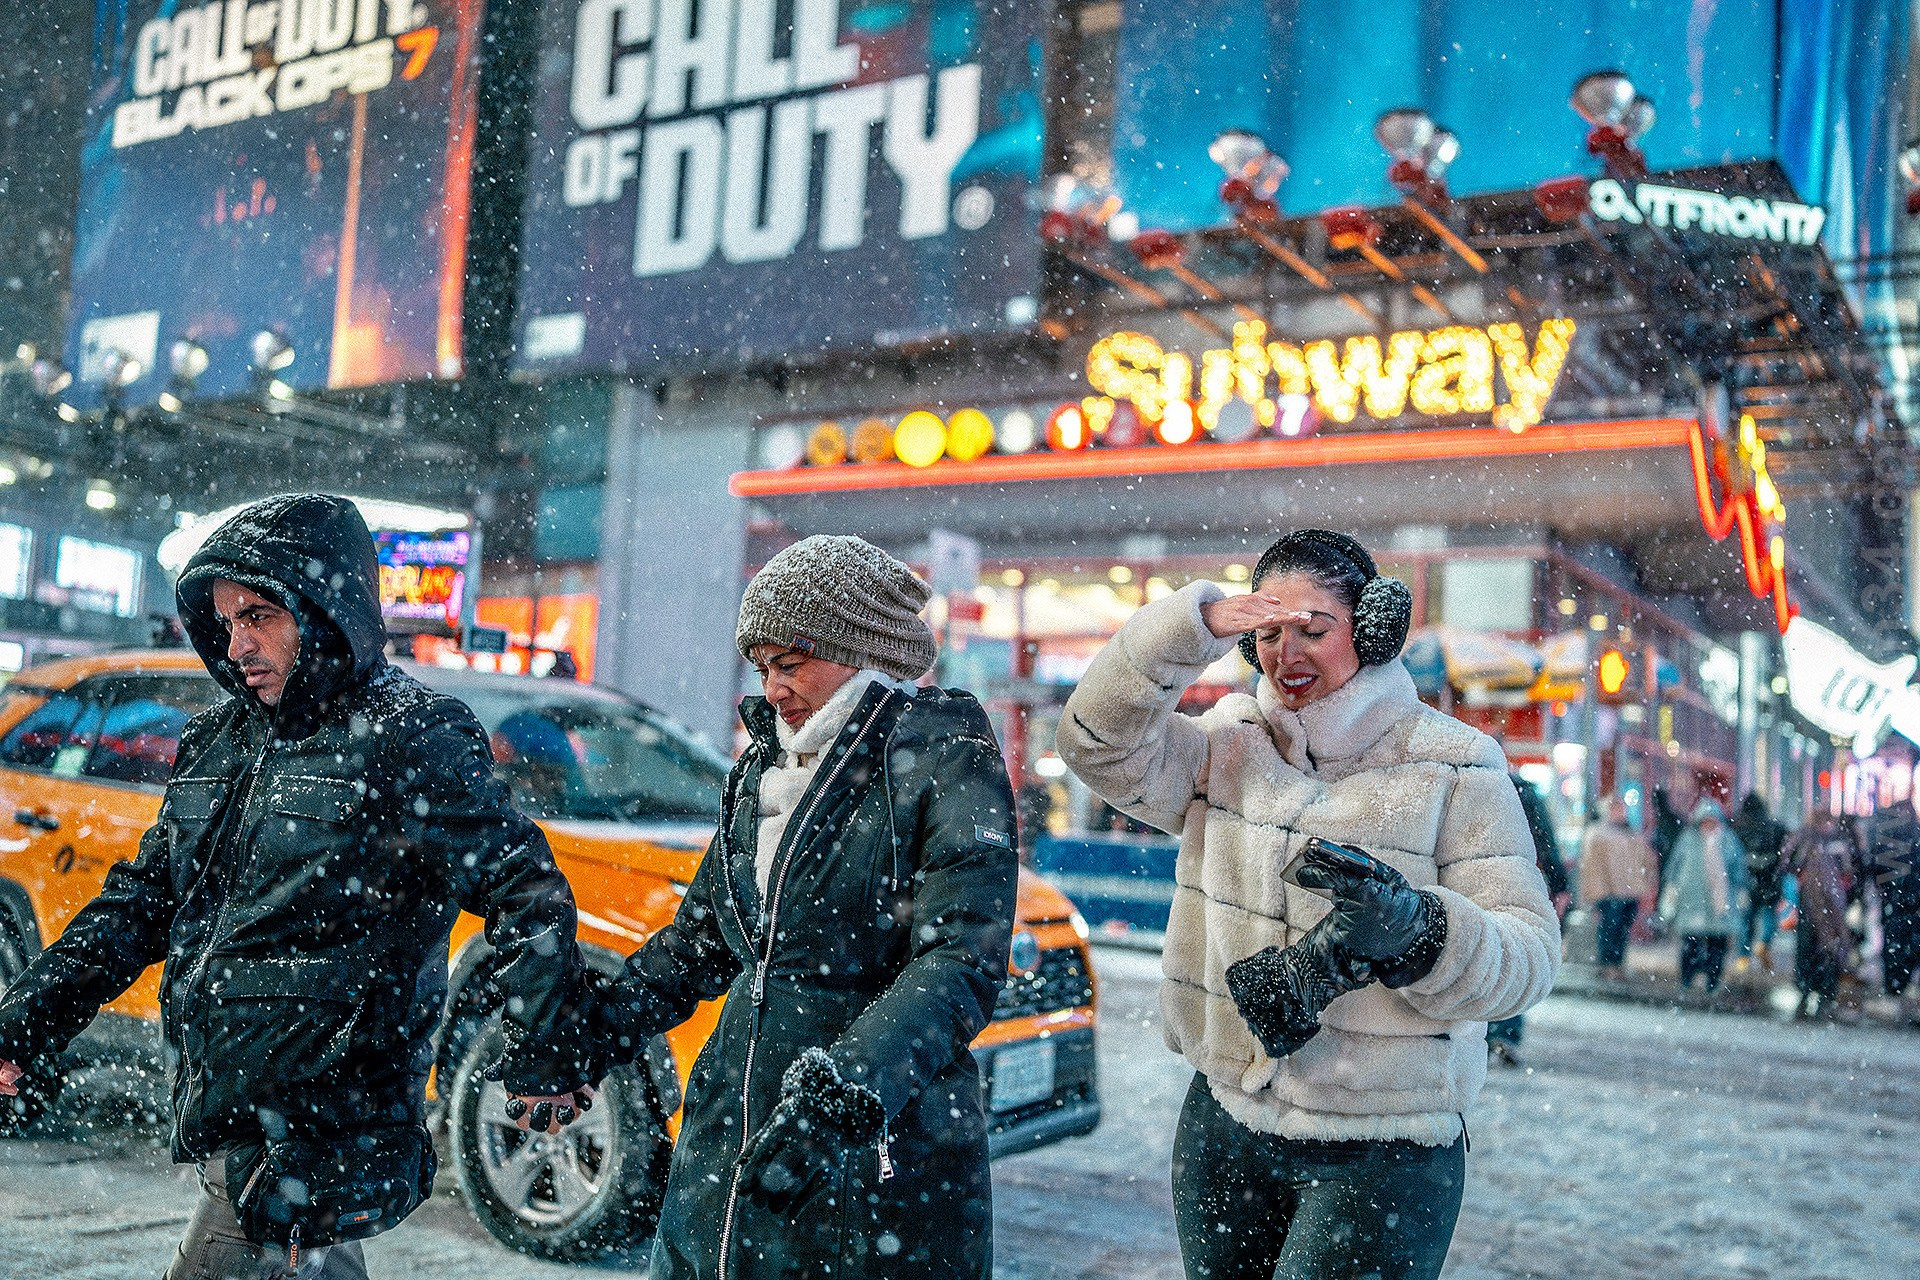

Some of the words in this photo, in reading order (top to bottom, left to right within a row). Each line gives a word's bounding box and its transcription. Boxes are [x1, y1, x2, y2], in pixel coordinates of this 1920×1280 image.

[112, 66, 276, 149] BLACK
[275, 37, 394, 112] OPS
[396, 26, 440, 80] 7
[134, 0, 253, 96] CALL
[570, 0, 861, 131] CALL
[564, 132, 642, 208] OF
[633, 63, 983, 277] DUTY
[289, 1243, 298, 1268] TOTTO
